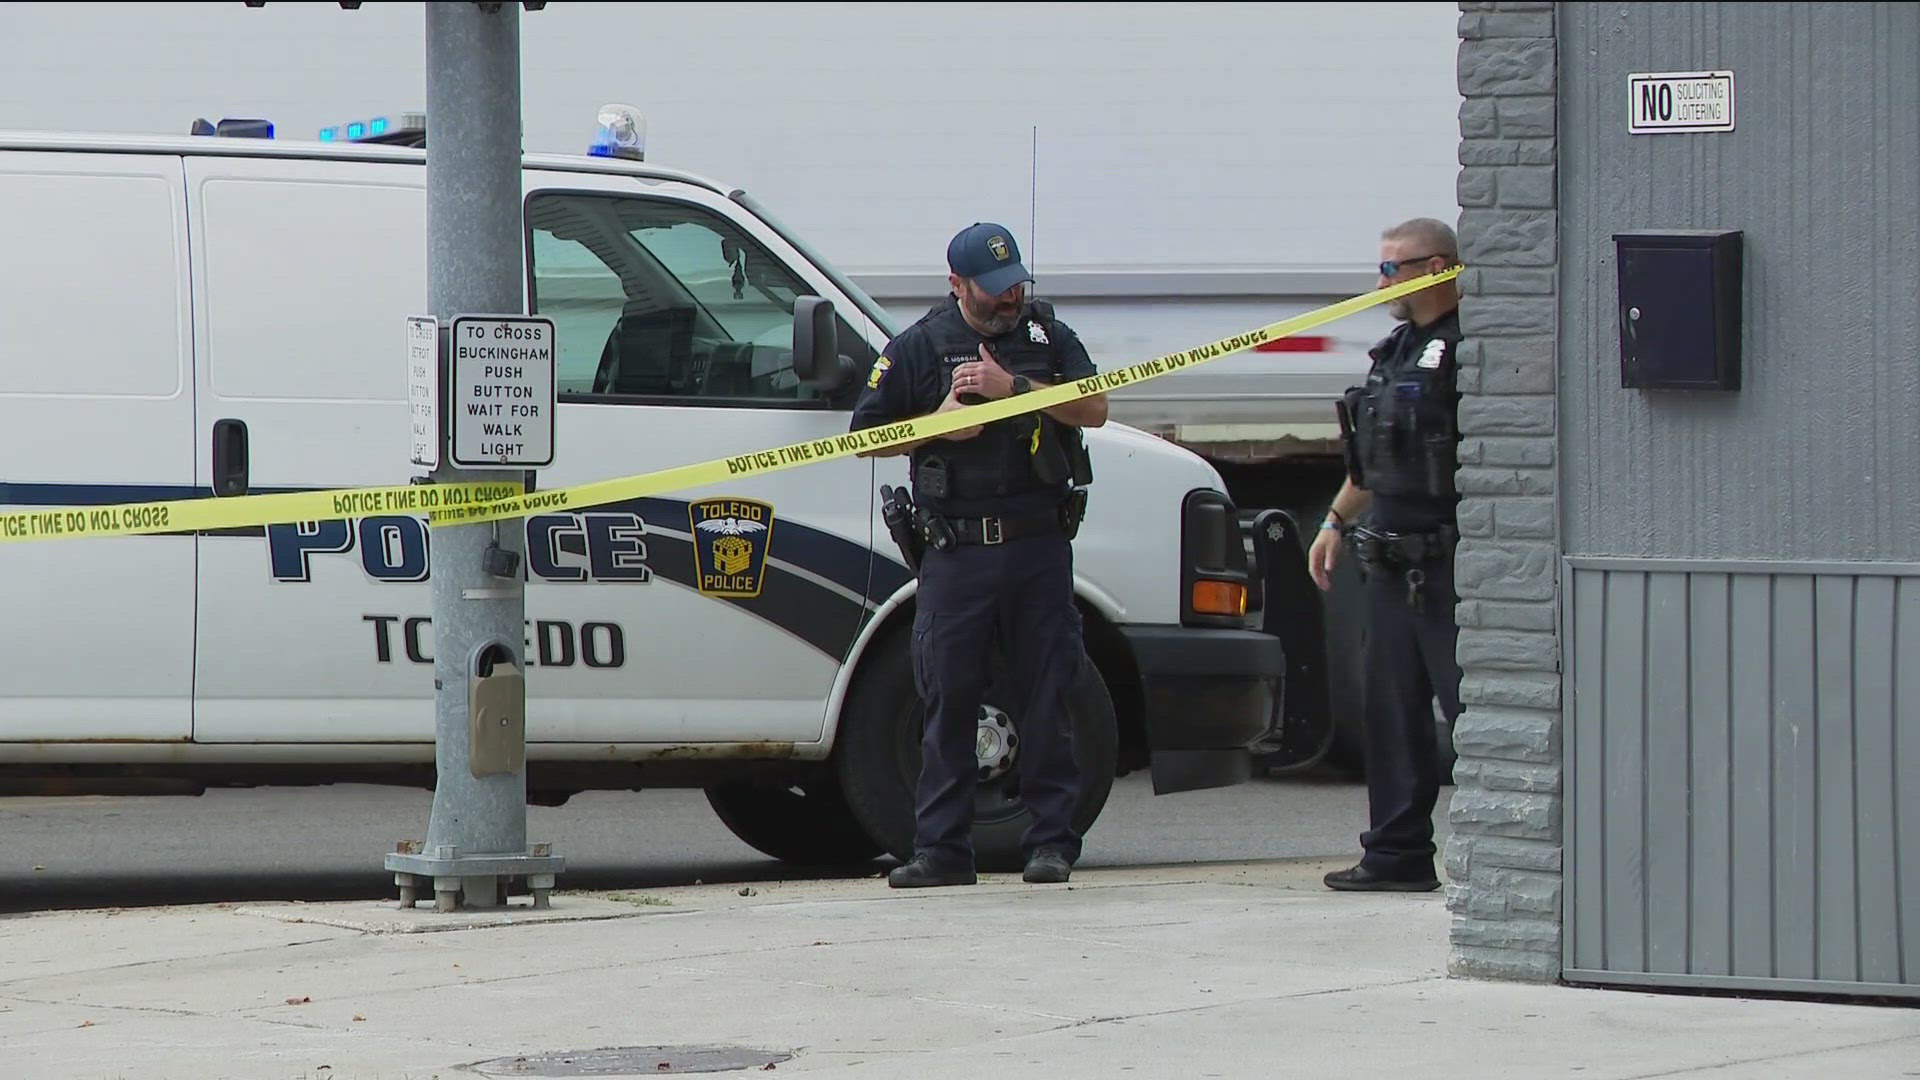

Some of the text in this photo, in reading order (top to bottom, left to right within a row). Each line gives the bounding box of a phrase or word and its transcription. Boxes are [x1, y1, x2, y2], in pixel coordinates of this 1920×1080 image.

[1677, 82, 1724, 100] SOLICITING
[1641, 83, 1673, 122] NO
[1677, 103, 1721, 121] LOITERING
[467, 326, 542, 340] TO CROSS
[459, 347, 549, 360] BUCKINGHAM
[485, 366, 523, 379] PUSH
[474, 385, 533, 398] BUTTON
[467, 404, 539, 417] WAIT FOR
[483, 423, 522, 436] WALK
[481, 444, 524, 455] LIGHT
[700, 502, 762, 520] TOLEDO
[267, 515, 648, 582] POCE
[704, 574, 754, 590] POLICE
[362, 615, 626, 668] TODO
